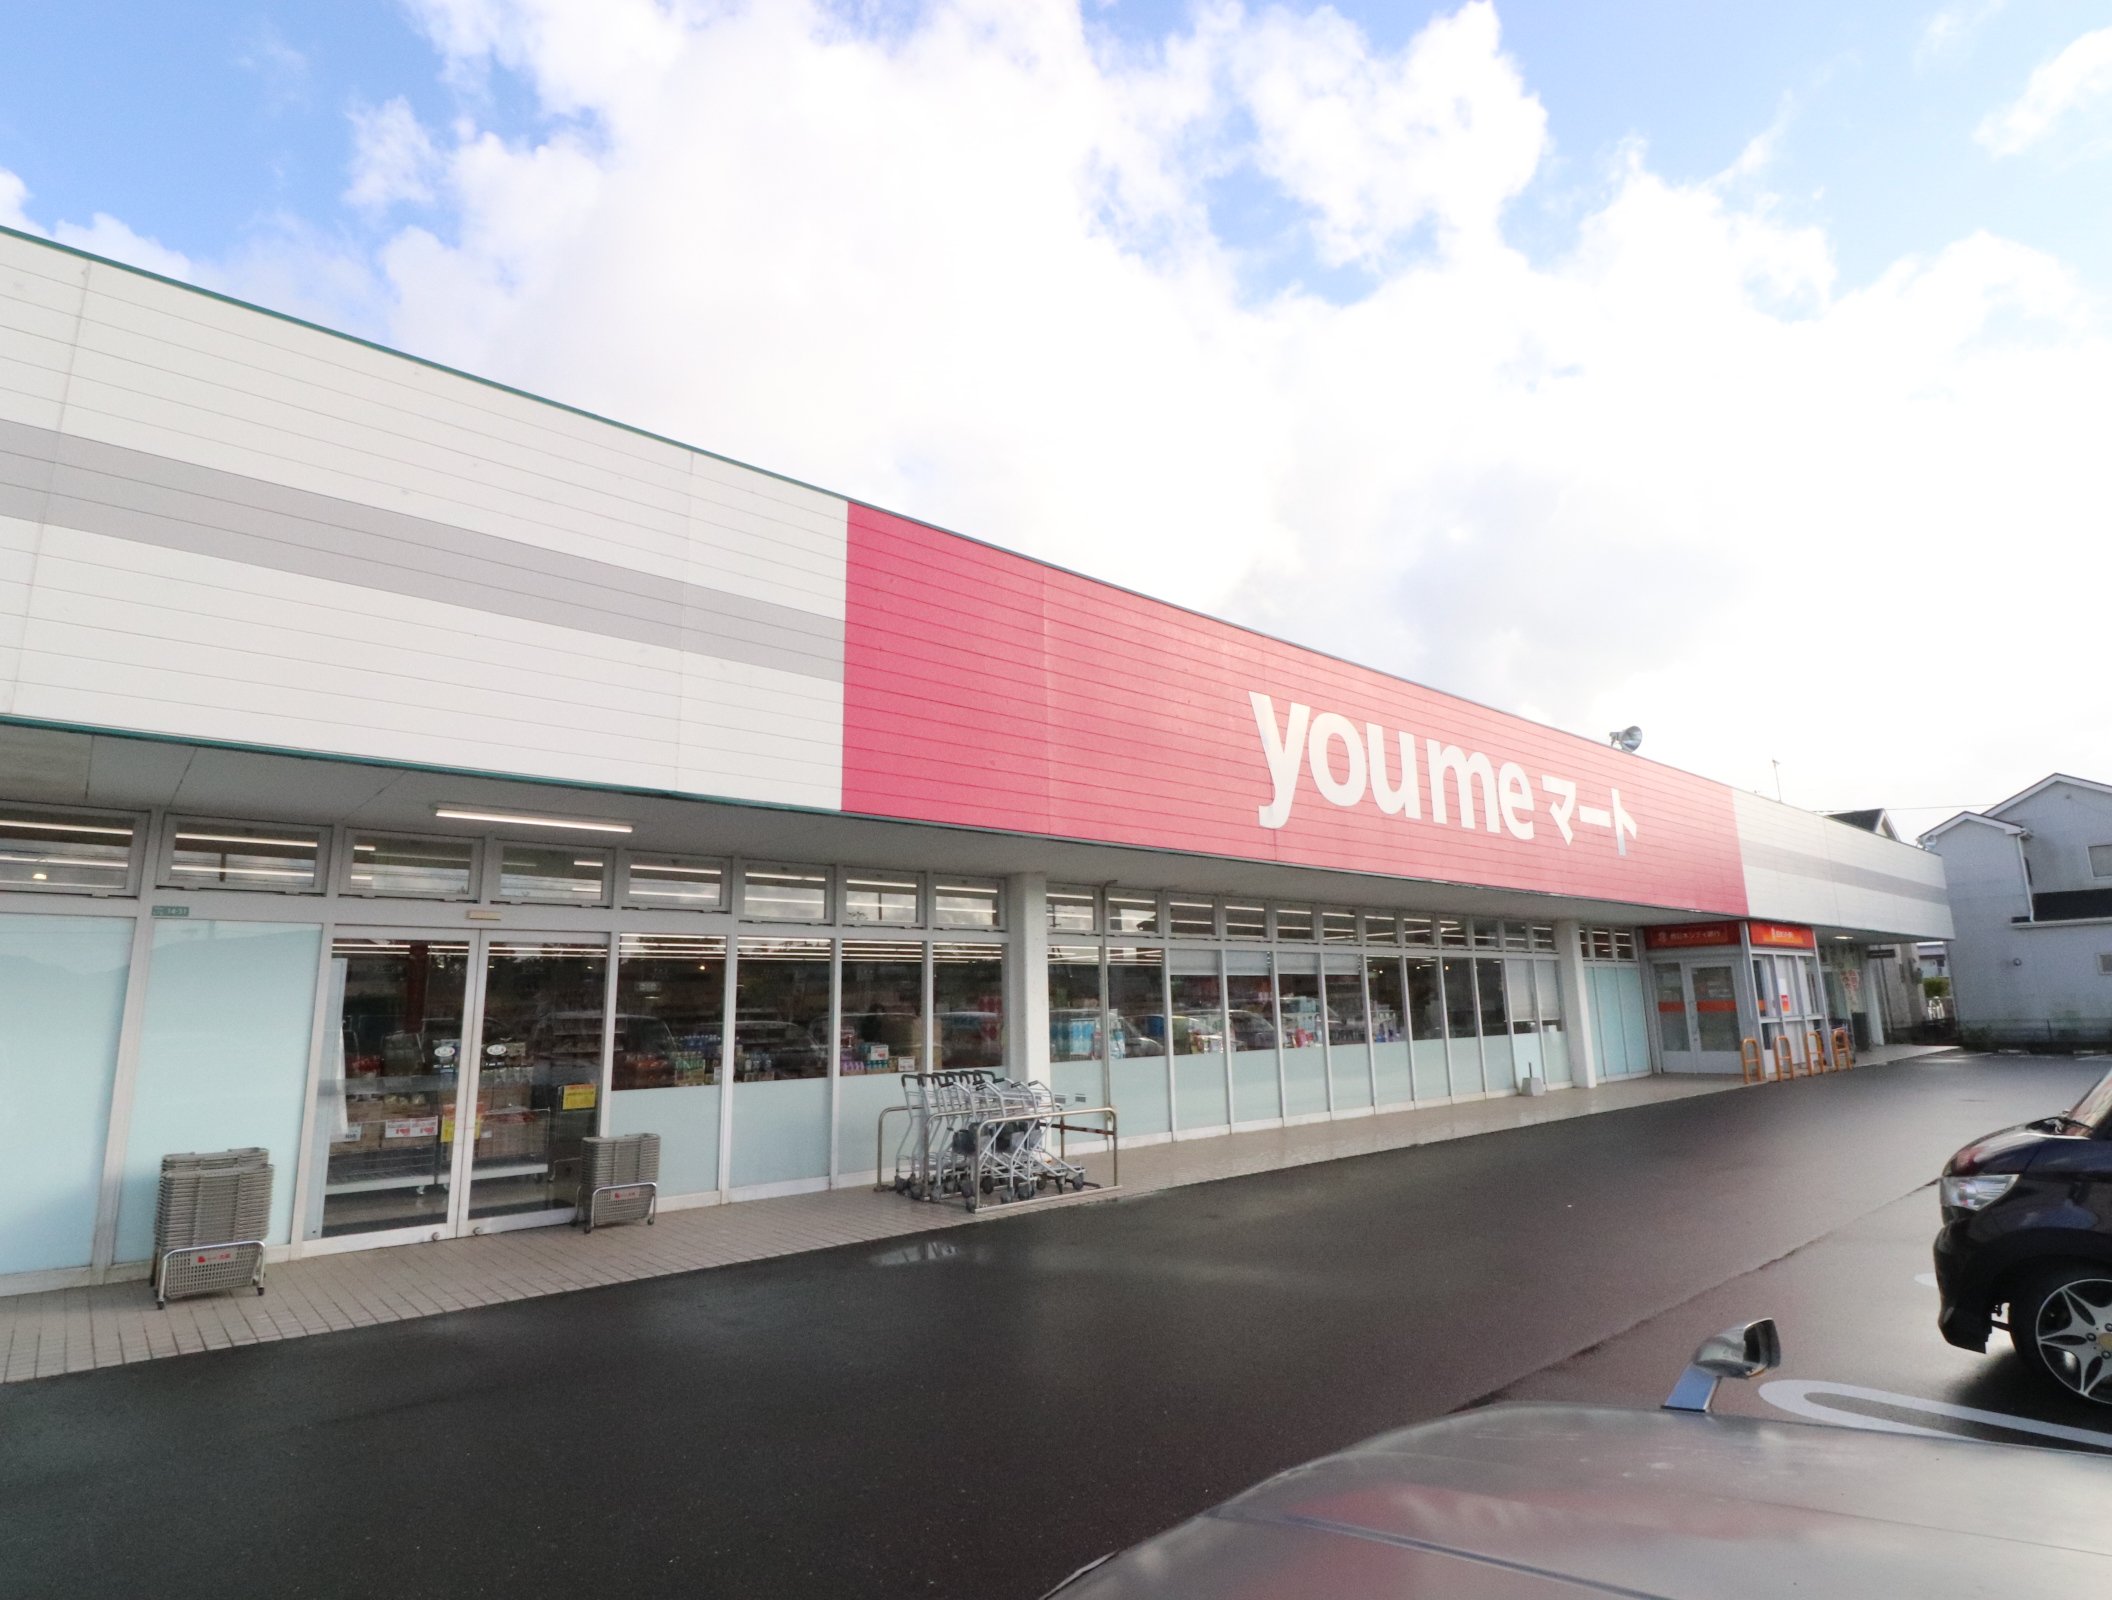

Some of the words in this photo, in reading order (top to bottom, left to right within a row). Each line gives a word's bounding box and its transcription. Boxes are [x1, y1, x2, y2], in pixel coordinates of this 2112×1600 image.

[1248, 691, 1535, 840] youme
[1541, 774, 1638, 856] マート
